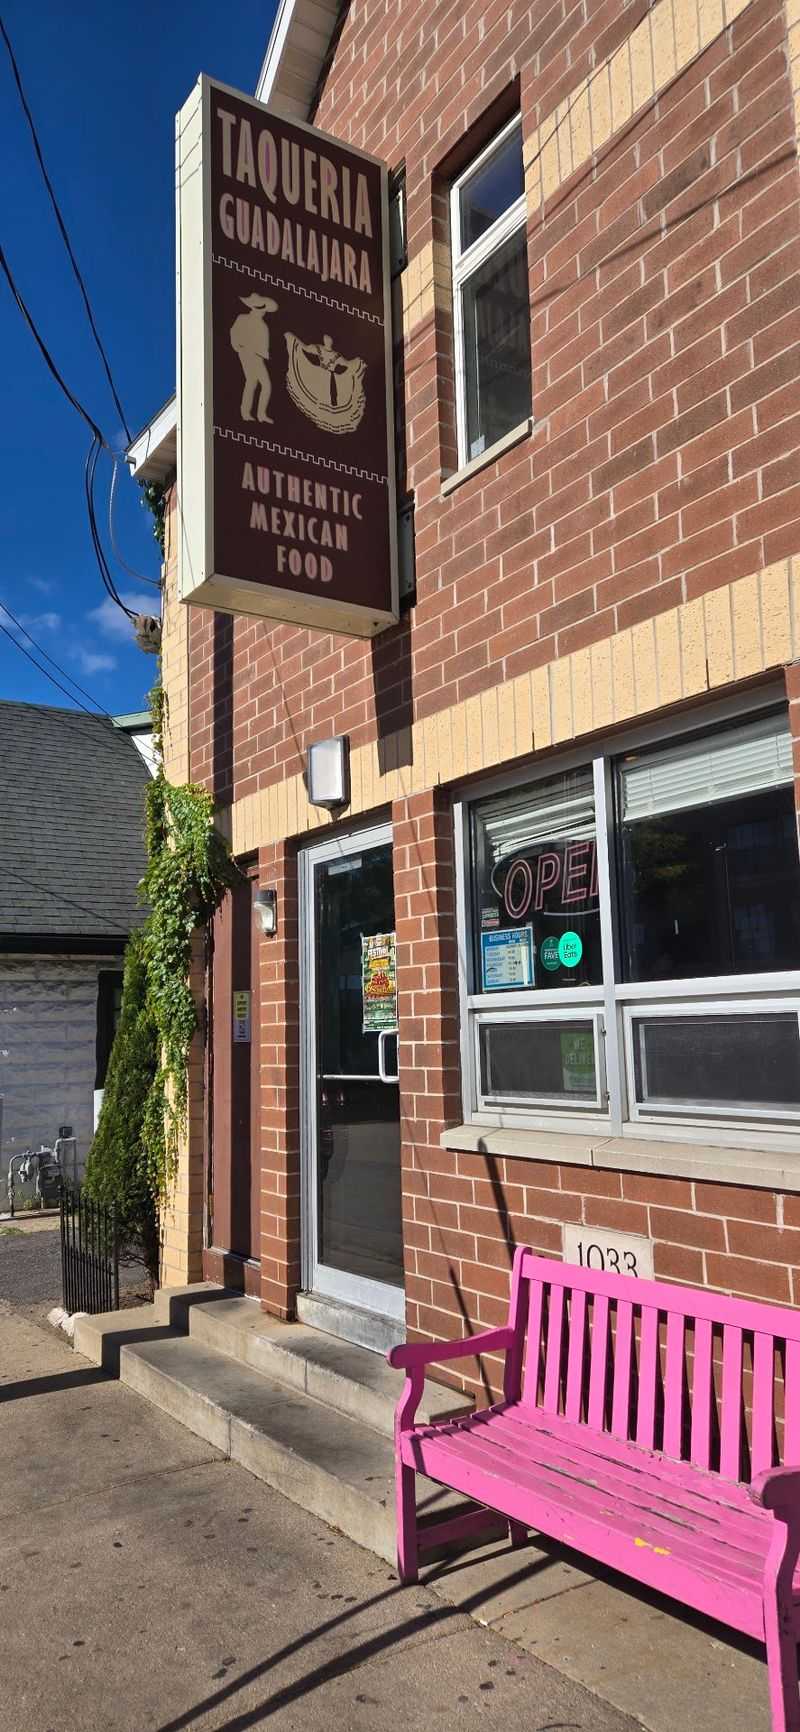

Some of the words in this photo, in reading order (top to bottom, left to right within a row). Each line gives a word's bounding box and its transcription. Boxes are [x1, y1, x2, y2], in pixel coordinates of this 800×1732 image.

[217, 108, 373, 238] TAQUERIA
[219, 193, 372, 294] GUADALAJARA
[241, 461, 363, 520] AUTHENTIC
[250, 501, 348, 551] MEXICAN
[277, 545, 333, 582] FOOD
[577, 1242, 638, 1278] 1033
